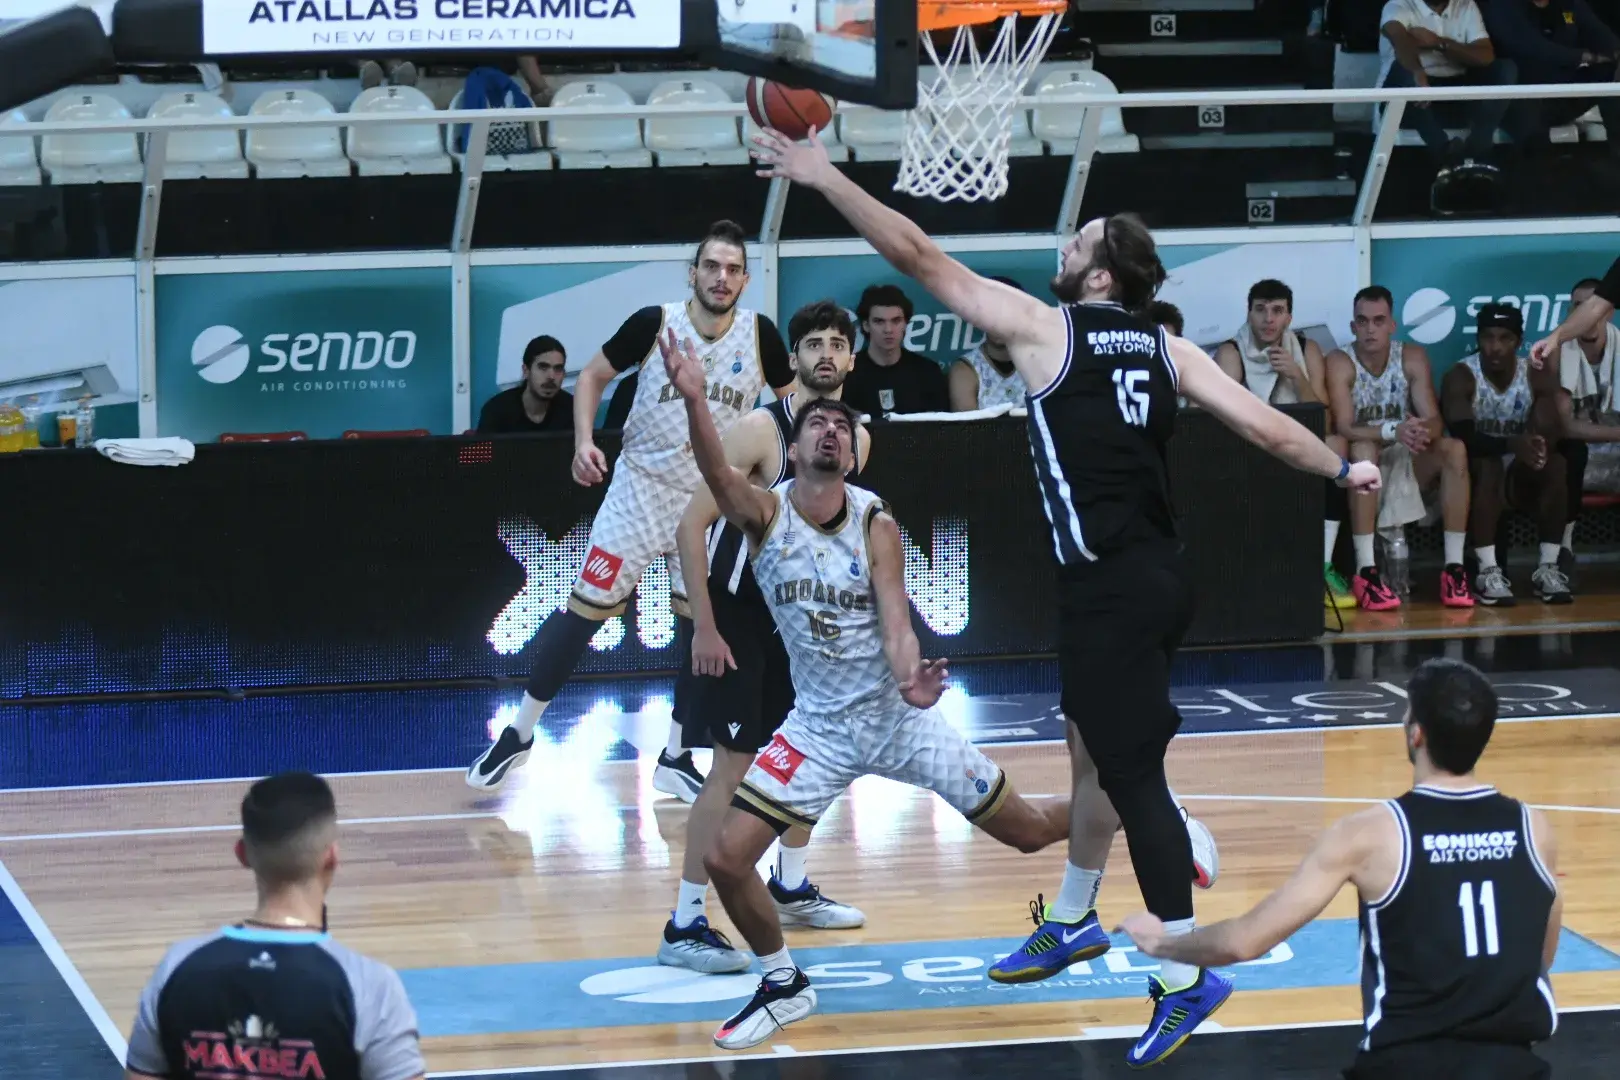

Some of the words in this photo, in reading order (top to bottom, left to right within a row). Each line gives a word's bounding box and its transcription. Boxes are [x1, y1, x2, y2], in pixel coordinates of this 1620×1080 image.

[248, 0, 419, 23] ATALLAS
[434, 0, 637, 19] CERAMICA
[312, 30, 376, 44] NEW
[386, 27, 575, 43] GENERATION
[1154, 20, 1174, 33] 04
[1202, 111, 1223, 124] 03
[1250, 205, 1272, 219] 02
[260, 382, 286, 392] AIR
[293, 378, 408, 391] CONDITIONING
[1112, 368, 1150, 428] 15
[586, 555, 614, 581] illy
[805, 609, 842, 641] 16
[766, 743, 791, 770] illy
[1422, 831, 1517, 850] ΕΘΝΙΚΟΣ
[1430, 846, 1514, 863] ΔΙΣΤΟΜΟΥ
[1459, 880, 1499, 957] 11
